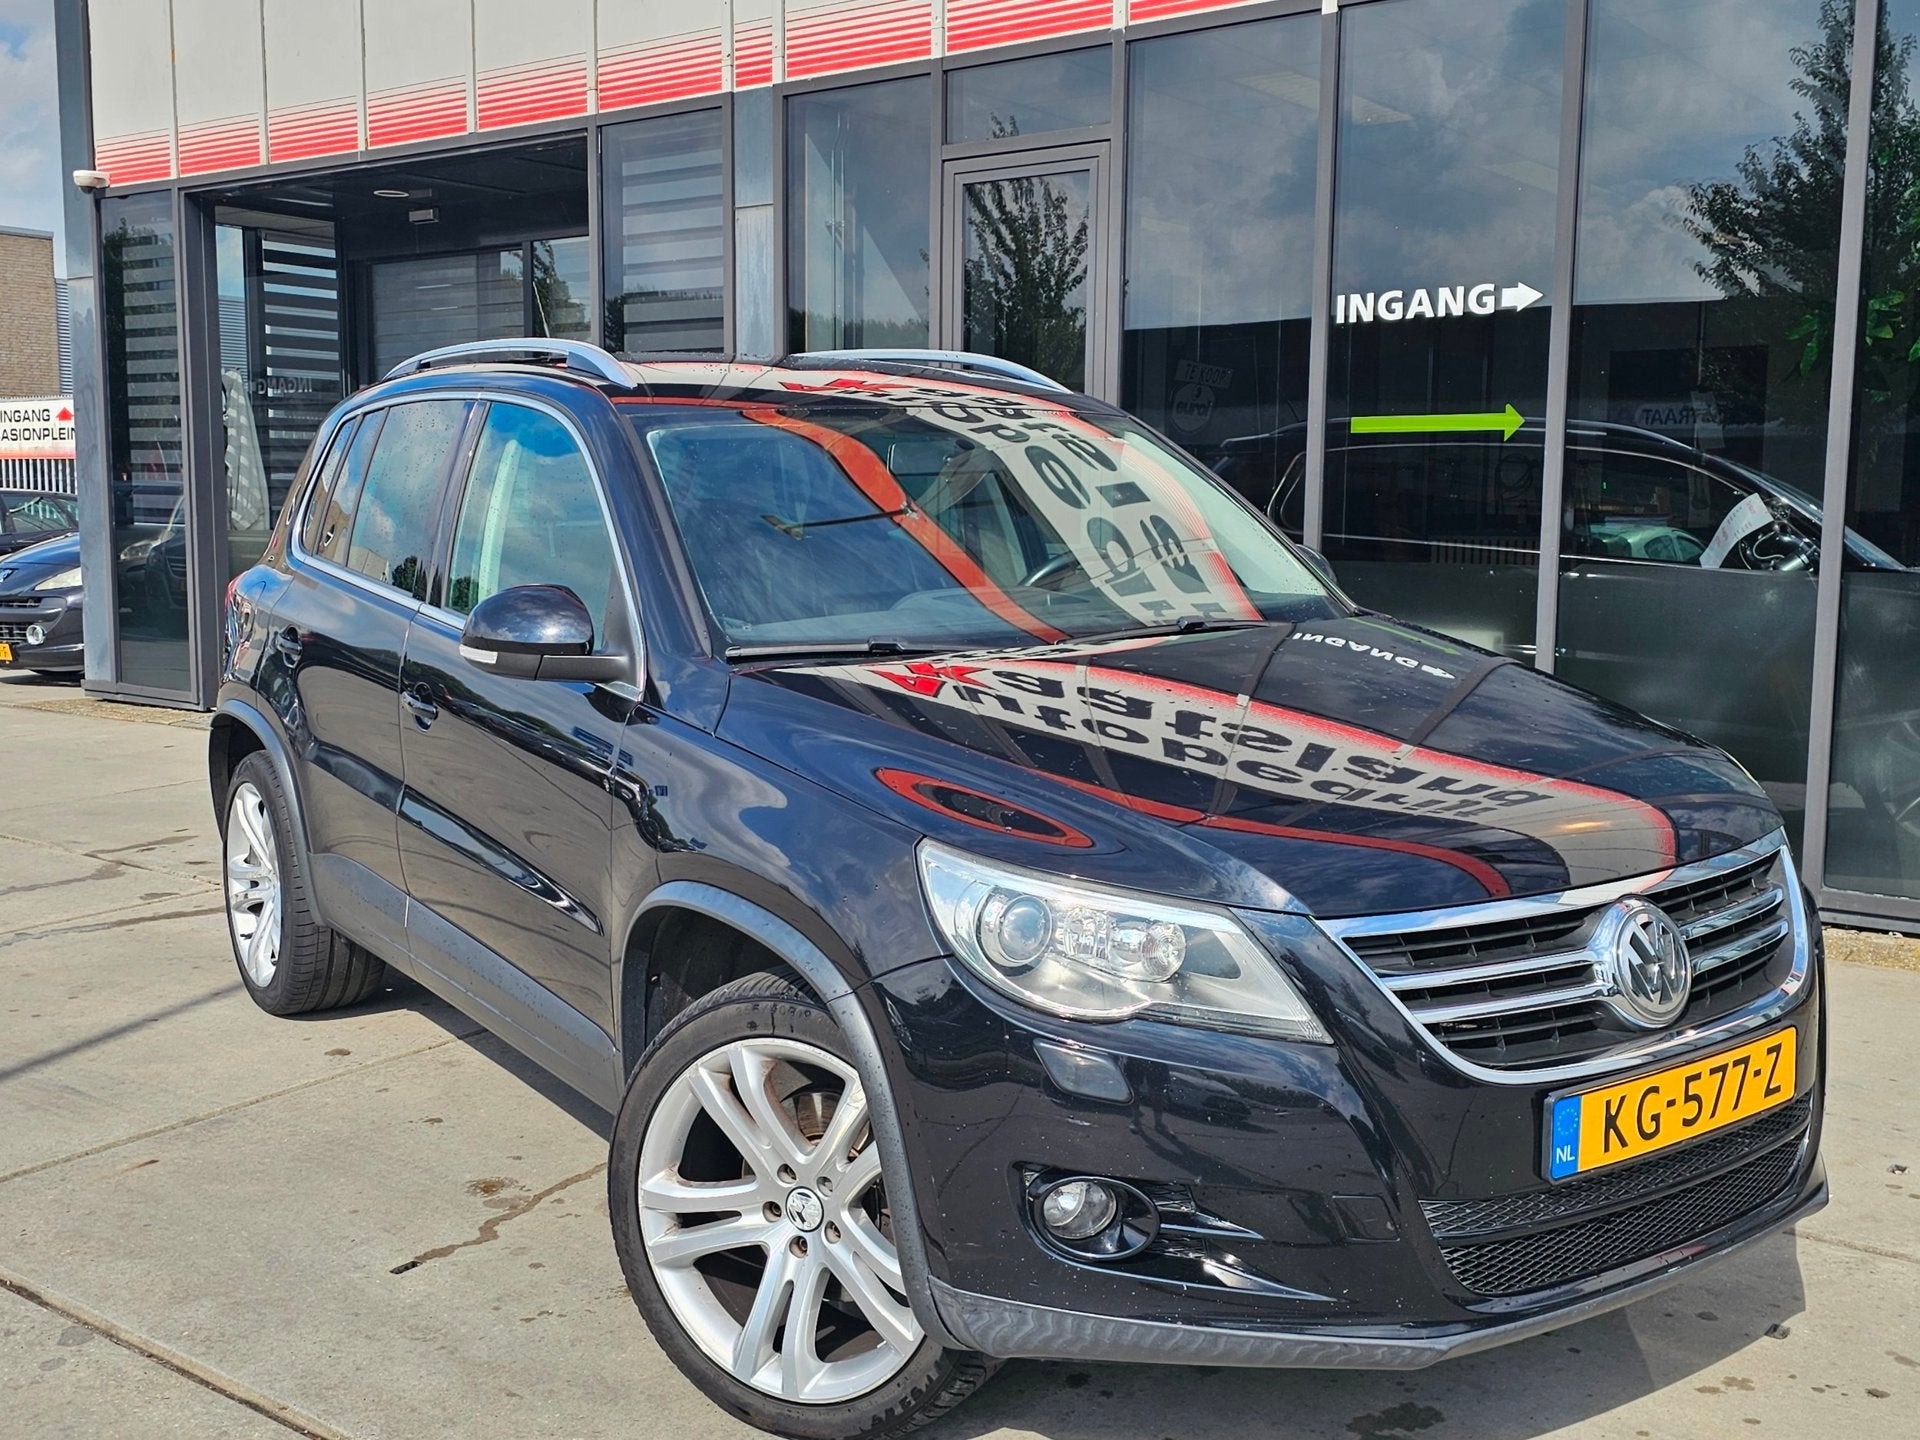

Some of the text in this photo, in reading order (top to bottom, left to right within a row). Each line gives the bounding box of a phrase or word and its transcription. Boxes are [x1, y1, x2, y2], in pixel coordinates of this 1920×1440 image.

[1336, 283, 1495, 324] INGANG
[0, 409, 50, 423] INGANG
[1603, 1042, 1783, 1154] KG-577-Z
[1556, 1144, 1576, 1164] NL
